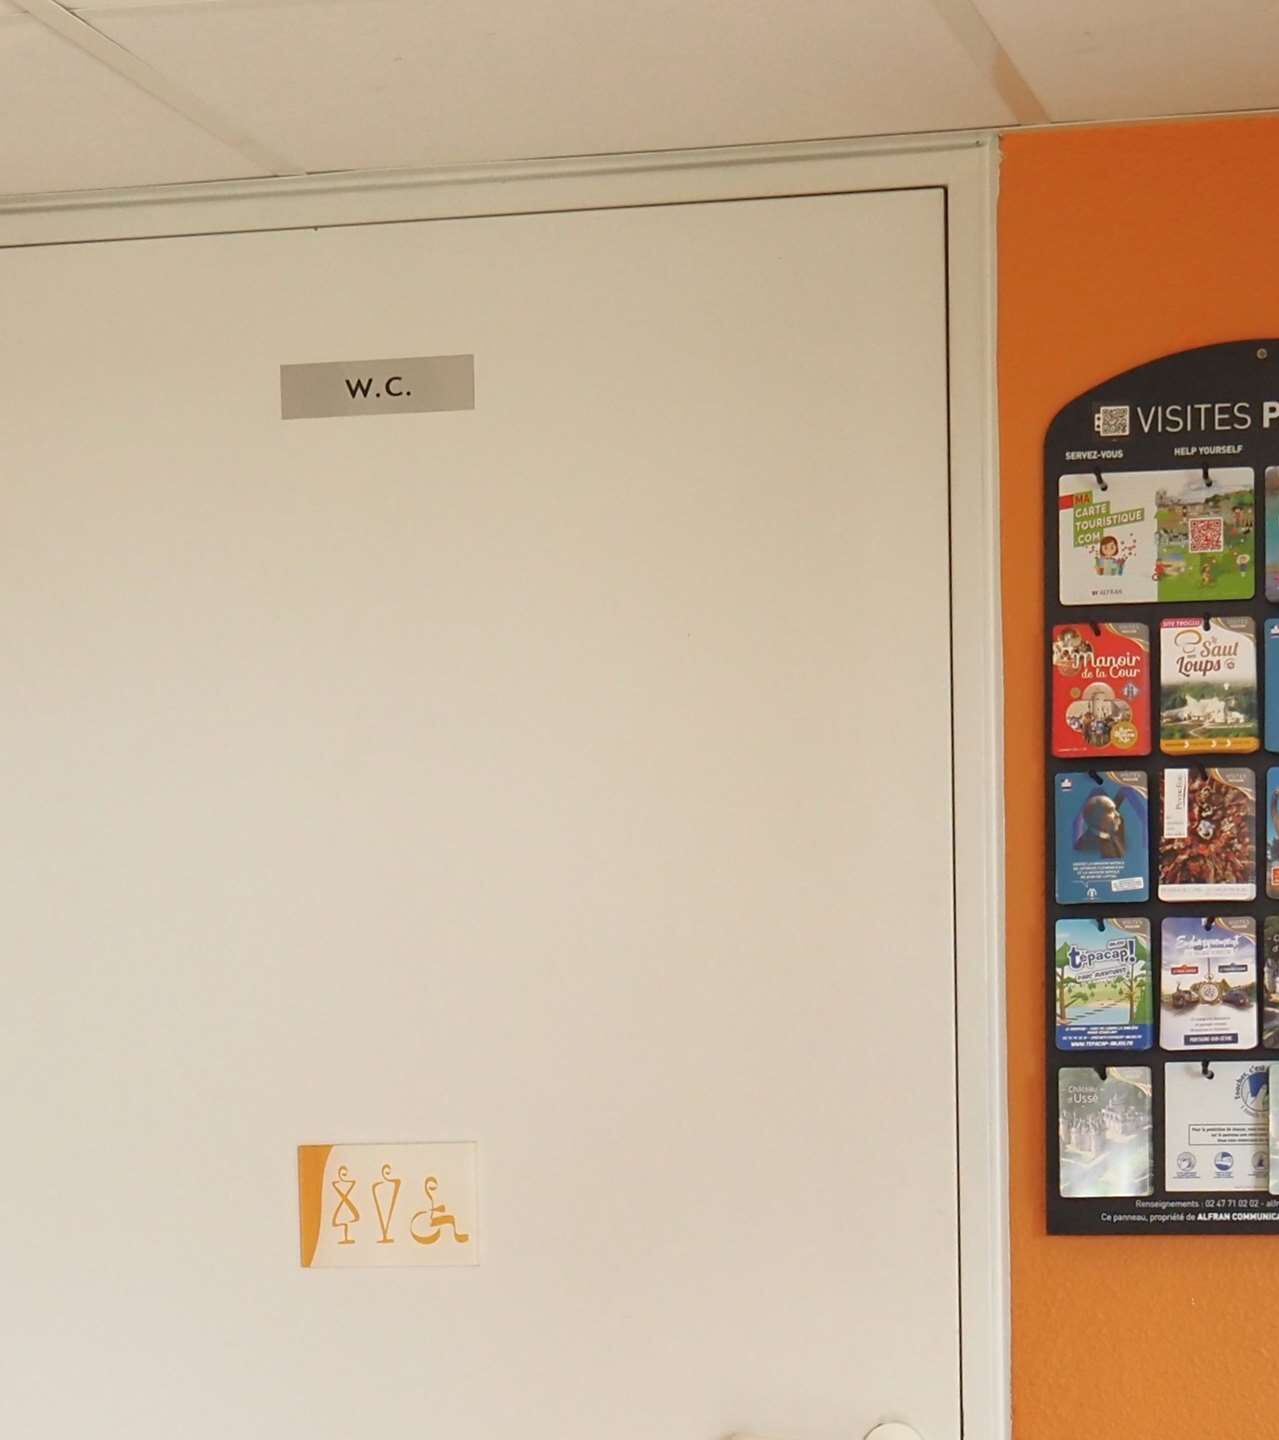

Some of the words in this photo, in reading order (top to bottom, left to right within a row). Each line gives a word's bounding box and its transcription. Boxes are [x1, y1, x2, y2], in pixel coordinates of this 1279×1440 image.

[345, 376, 411, 398] W.C.
[1136, 402, 1252, 433] VISITES
[1065, 450, 1123, 460] SERVEZ-VOUS
[1174, 447, 1197, 456] HELP
[1199, 445, 1242, 454] YOURSELF
[1075, 506, 1107, 517] CARTE
[1075, 511, 1142, 530] TOURISTIQUE
[1201, 641, 1239, 658] Saut
[1072, 653, 1141, 668] Manoir
[1176, 657, 1222, 677] Loups
[1082, 669, 1093, 678] de
[1096, 668, 1106, 678] la
[1109, 666, 1141, 678] Cour
[1136, 1200, 1199, 1209] Renseignements
[1113, 1214, 1148, 1222] panneau,
[1150, 1213, 1184, 1222] propriété
